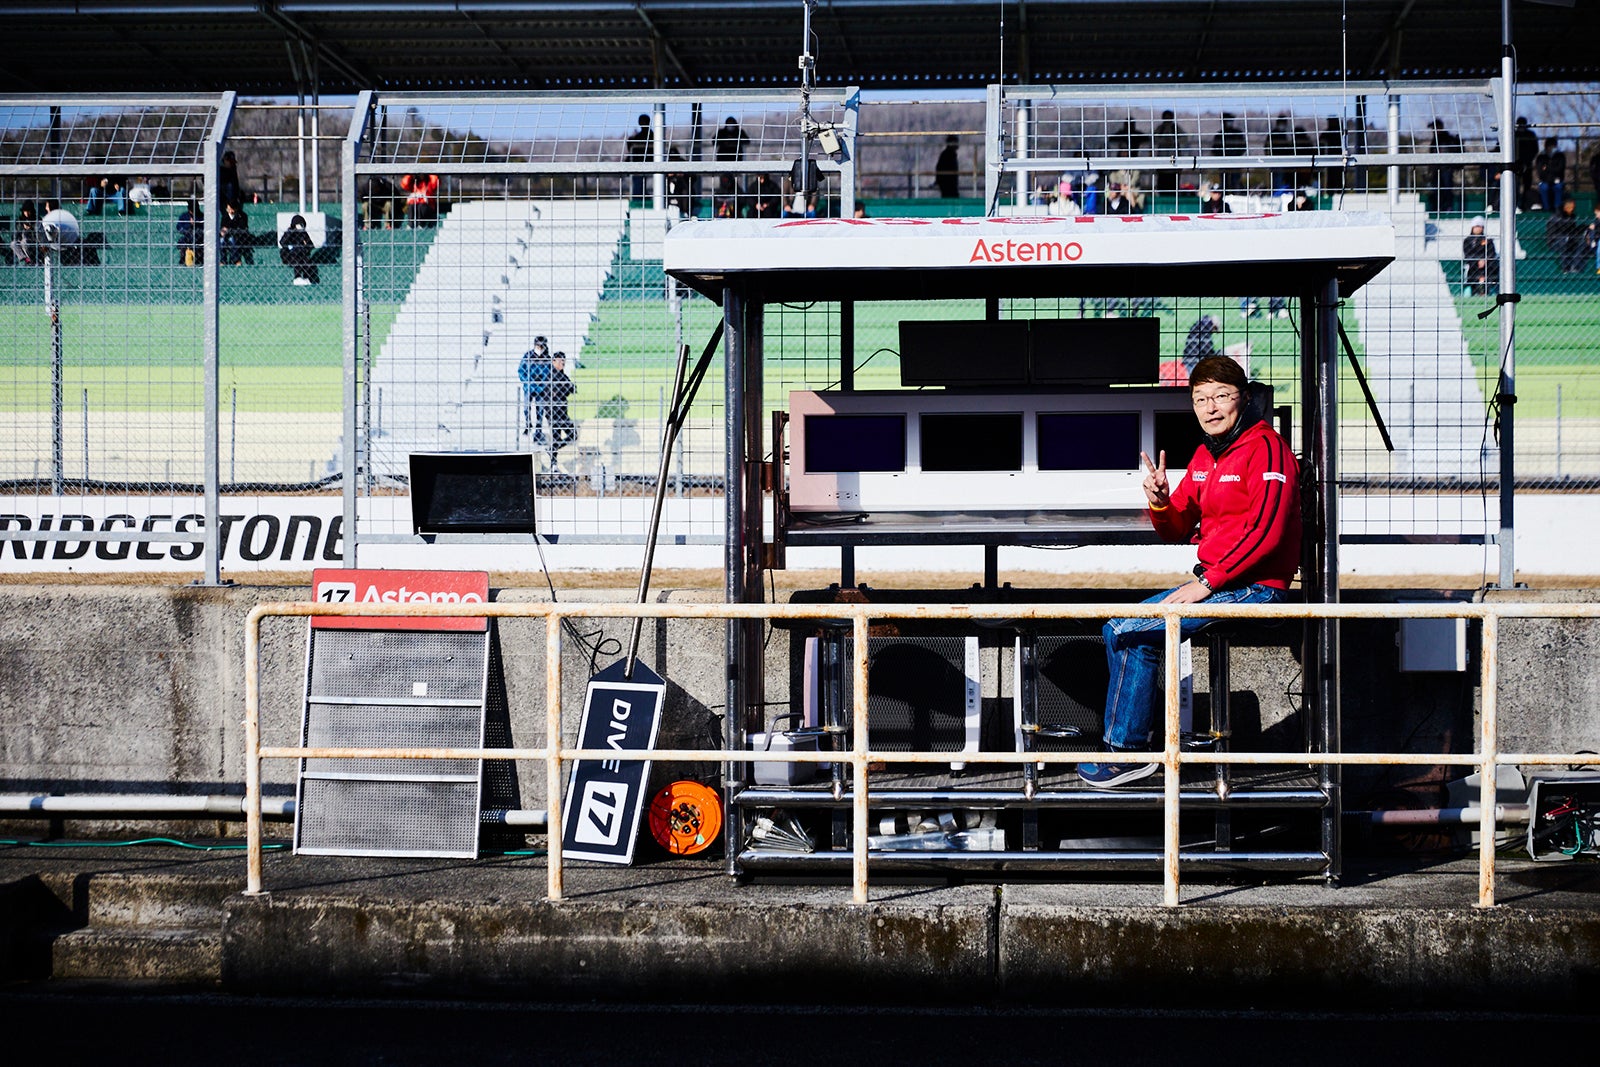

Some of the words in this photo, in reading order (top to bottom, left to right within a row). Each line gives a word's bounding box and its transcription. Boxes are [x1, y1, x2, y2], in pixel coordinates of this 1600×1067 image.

[969, 239, 1083, 263] Astemo
[321, 589, 350, 603] 17
[361, 585, 483, 603] Astemo
[602, 698, 632, 774] DIVE
[588, 790, 616, 838] 17
